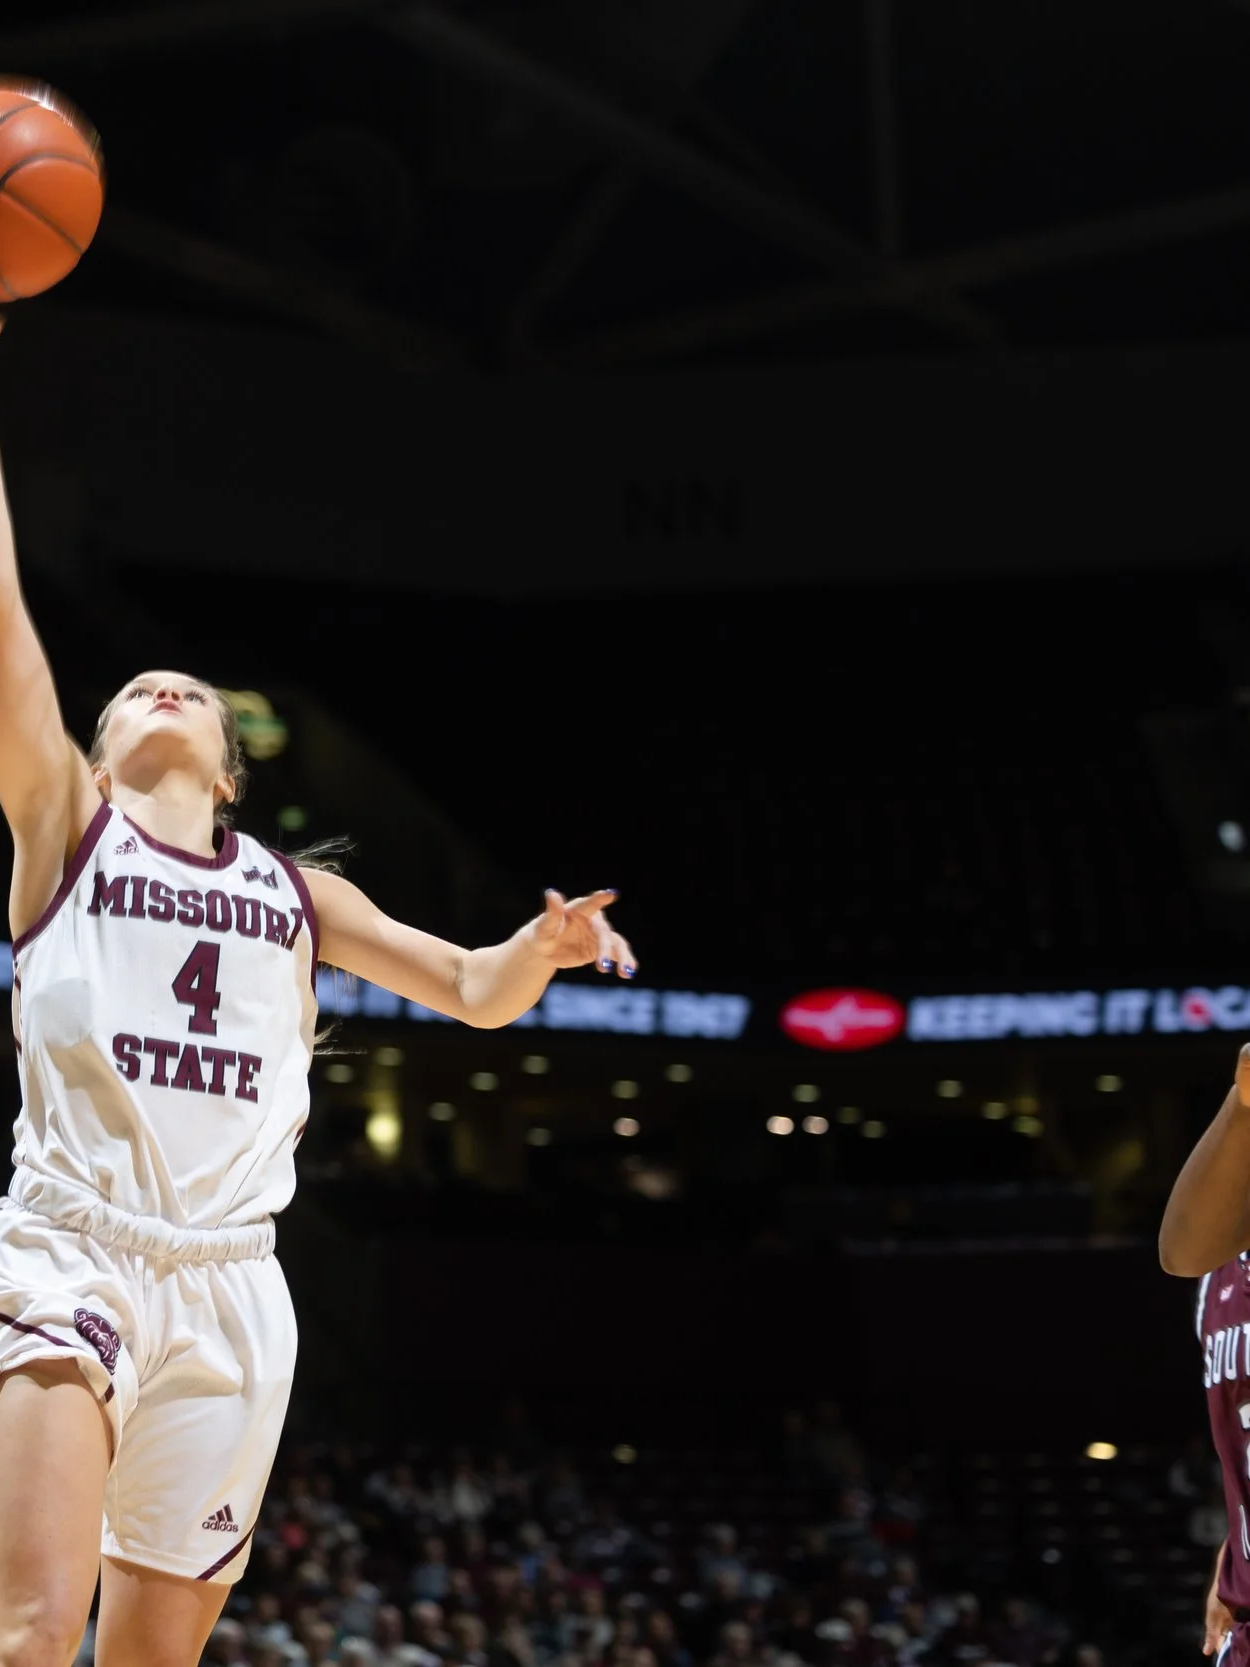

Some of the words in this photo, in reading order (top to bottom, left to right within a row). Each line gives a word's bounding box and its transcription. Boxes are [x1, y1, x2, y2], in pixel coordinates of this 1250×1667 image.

[87, 870, 304, 951] MISSOURI
[171, 940, 221, 1036] 4
[906, 990, 1099, 1042] KEEPING
[1104, 988, 1151, 1034] IT
[112, 1032, 262, 1104] STATE
[202, 1519, 238, 1533] adidas
